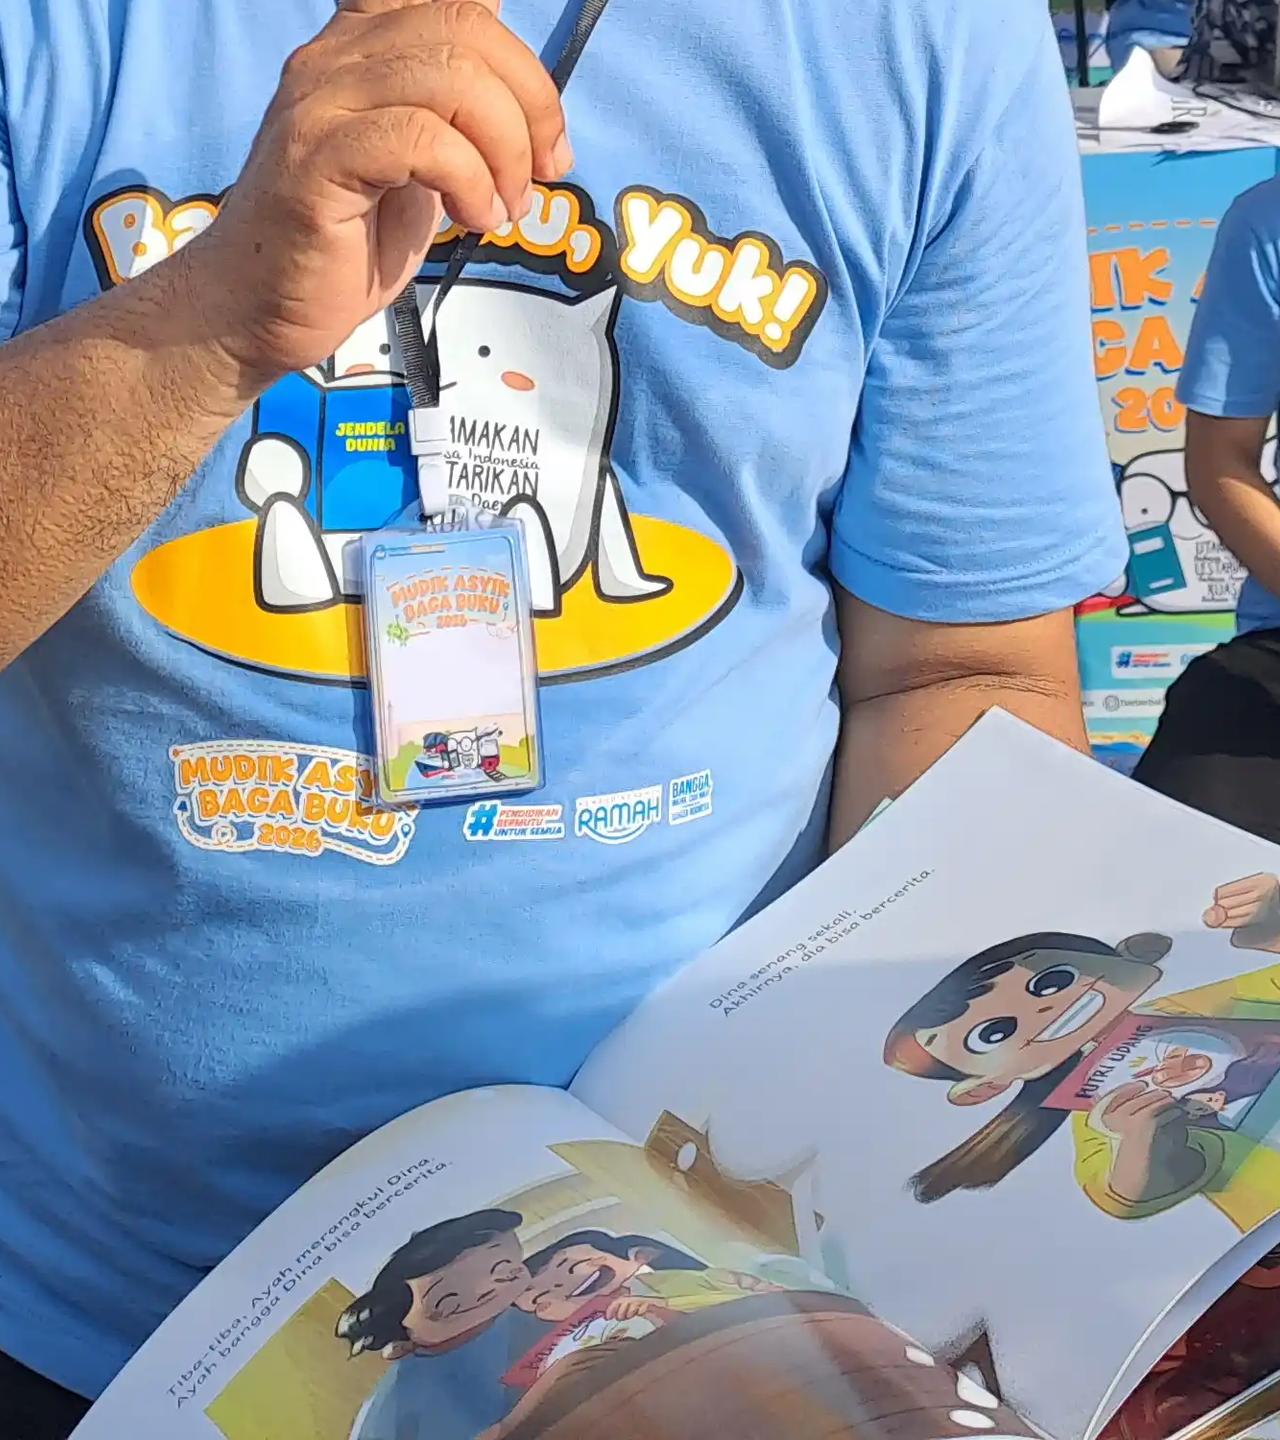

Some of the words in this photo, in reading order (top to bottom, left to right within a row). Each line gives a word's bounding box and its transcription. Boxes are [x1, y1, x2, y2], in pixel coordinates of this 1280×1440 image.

[94, 191, 222, 285] Ba
[621, 190, 818, 354] Yuk!
[335, 421, 406, 437] JENDELA
[345, 438, 397, 453] DUNIA
[468, 448, 541, 471] Indonesia
[390, 575, 450, 608] MUDIK
[453, 573, 513, 599] ASYIK
[403, 595, 453, 623] BACA
[455, 592, 503, 616] BUKU
[179, 753, 297, 788] MUDIK
[195, 787, 297, 821] BACA
[500, 808, 560, 818] PENDIDIKAN
[578, 796, 660, 833] RAMAH
[255, 822, 323, 854] 2026
[494, 827, 529, 837] UNTUK
[530, 826, 562, 836] SEMUA
[496, 818, 544, 828] BERMUTU
[723, 964, 801, 1018] Akhirnya,
[800, 944, 826, 964] dia
[825, 920, 861, 945] bisa
[858, 867, 937, 921] bercerita.
[709, 980, 749, 1010] Dina
[749, 941, 809, 981] senang
[166, 1314, 249, 1396] Tiba-tiba,
[250, 1266, 294, 1310] Ayah
[295, 1186, 386, 1265] merangkul
[386, 1156, 437, 1186] Dina.
[177, 1362, 218, 1409] Ayah
[218, 1295, 281, 1358] bangga
[282, 1254, 324, 1293] Dina
[323, 1221, 364, 1254] bisa
[362, 1159, 455, 1220] bercerita.
